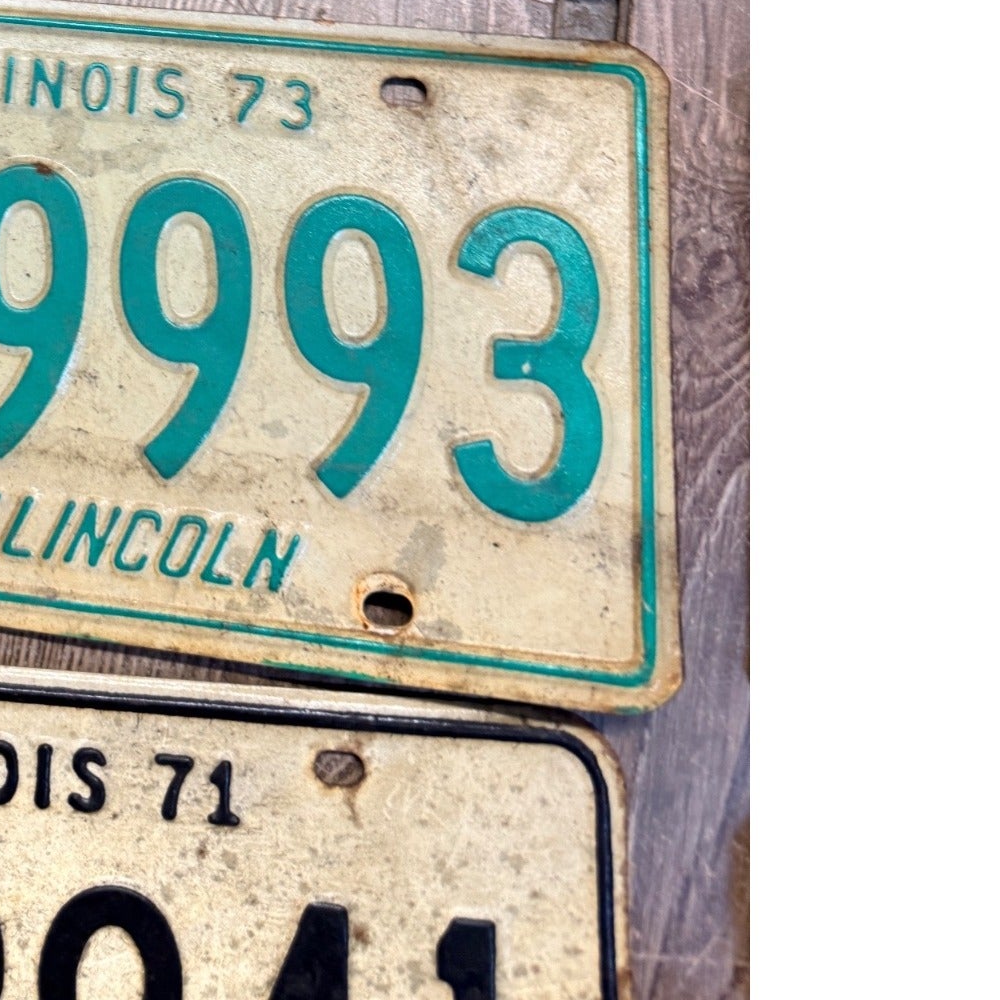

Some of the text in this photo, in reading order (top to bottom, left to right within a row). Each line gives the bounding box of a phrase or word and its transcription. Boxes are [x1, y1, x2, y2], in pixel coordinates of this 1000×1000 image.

[233, 74, 314, 131] 73
[0, 496, 302, 593] LINCOLN
[154, 753, 241, 828] 71
